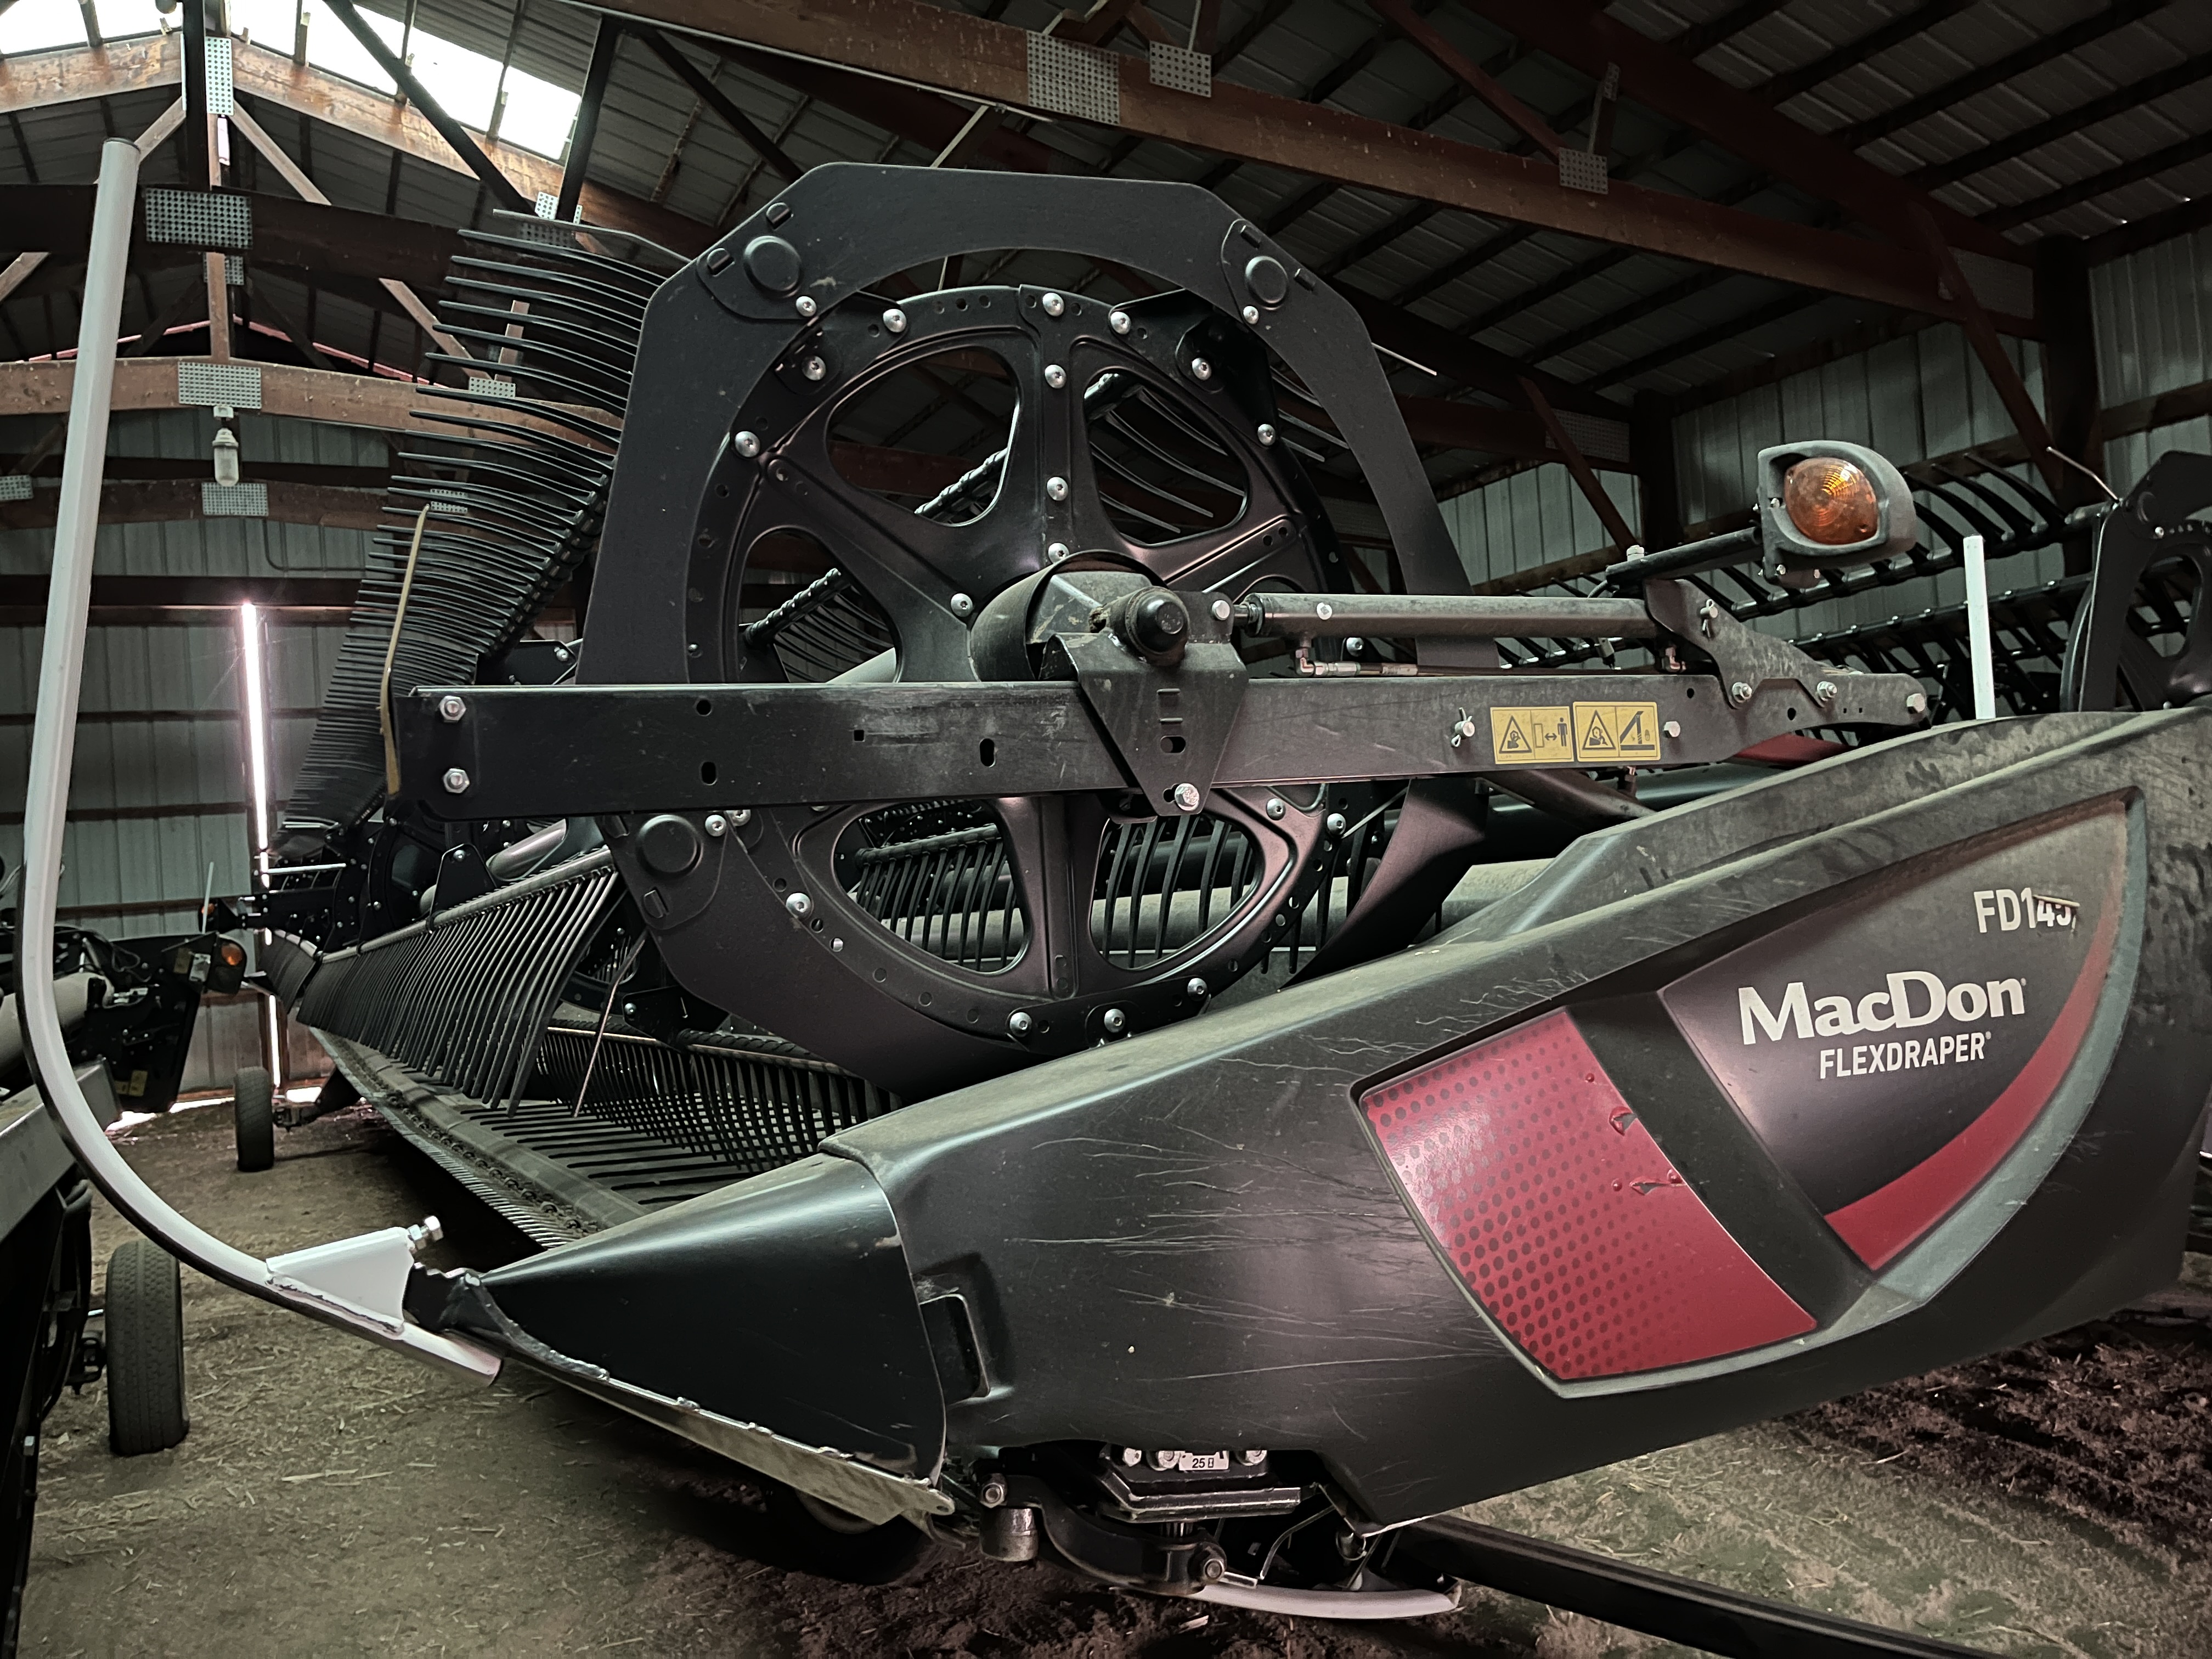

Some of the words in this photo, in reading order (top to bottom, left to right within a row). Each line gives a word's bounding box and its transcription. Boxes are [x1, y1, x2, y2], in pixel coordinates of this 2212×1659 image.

[1738, 970, 2026, 1045] MacDon
[1819, 1031, 1986, 1079] FLEXDRAPER
[1192, 1458, 1205, 1468] 25
